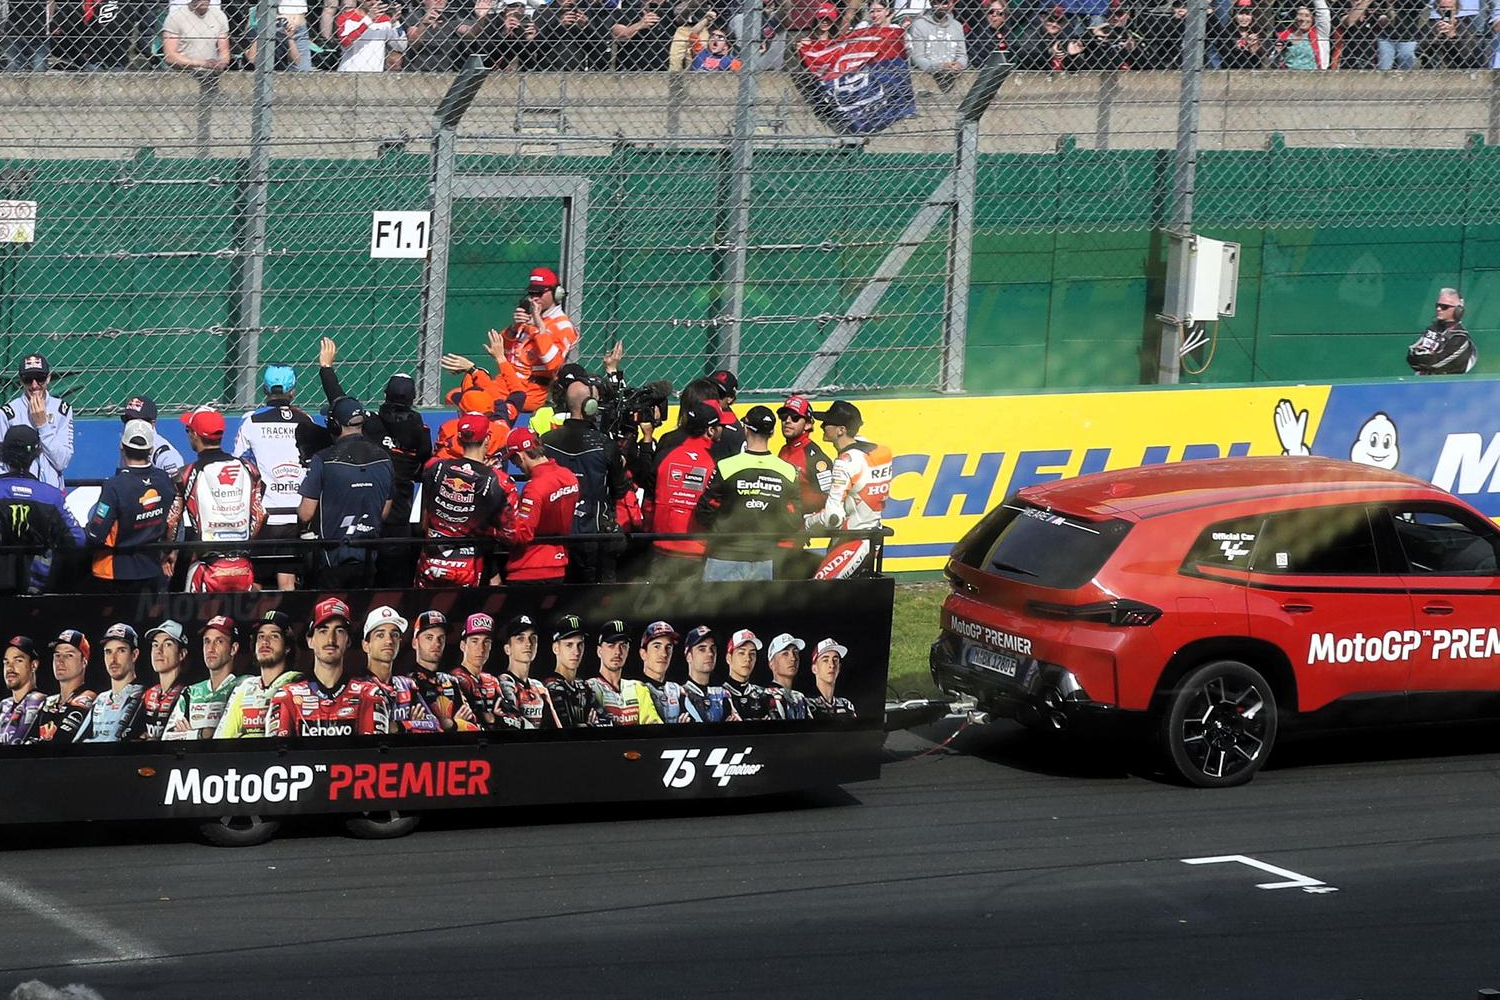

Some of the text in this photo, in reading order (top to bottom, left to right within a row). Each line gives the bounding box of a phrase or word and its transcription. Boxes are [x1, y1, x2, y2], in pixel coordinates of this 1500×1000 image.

[376, 221, 425, 249] F1.1
[736, 480, 782, 492] Enduro
[746, 499, 769, 511] ebay
[1212, 532, 1256, 541] Official Car
[815, 549, 854, 579] ONDA
[985, 629, 1033, 655] PREMIER
[301, 723, 352, 737] Lenovo
[329, 760, 491, 801] PREMIER
[660, 749, 700, 788] 75
